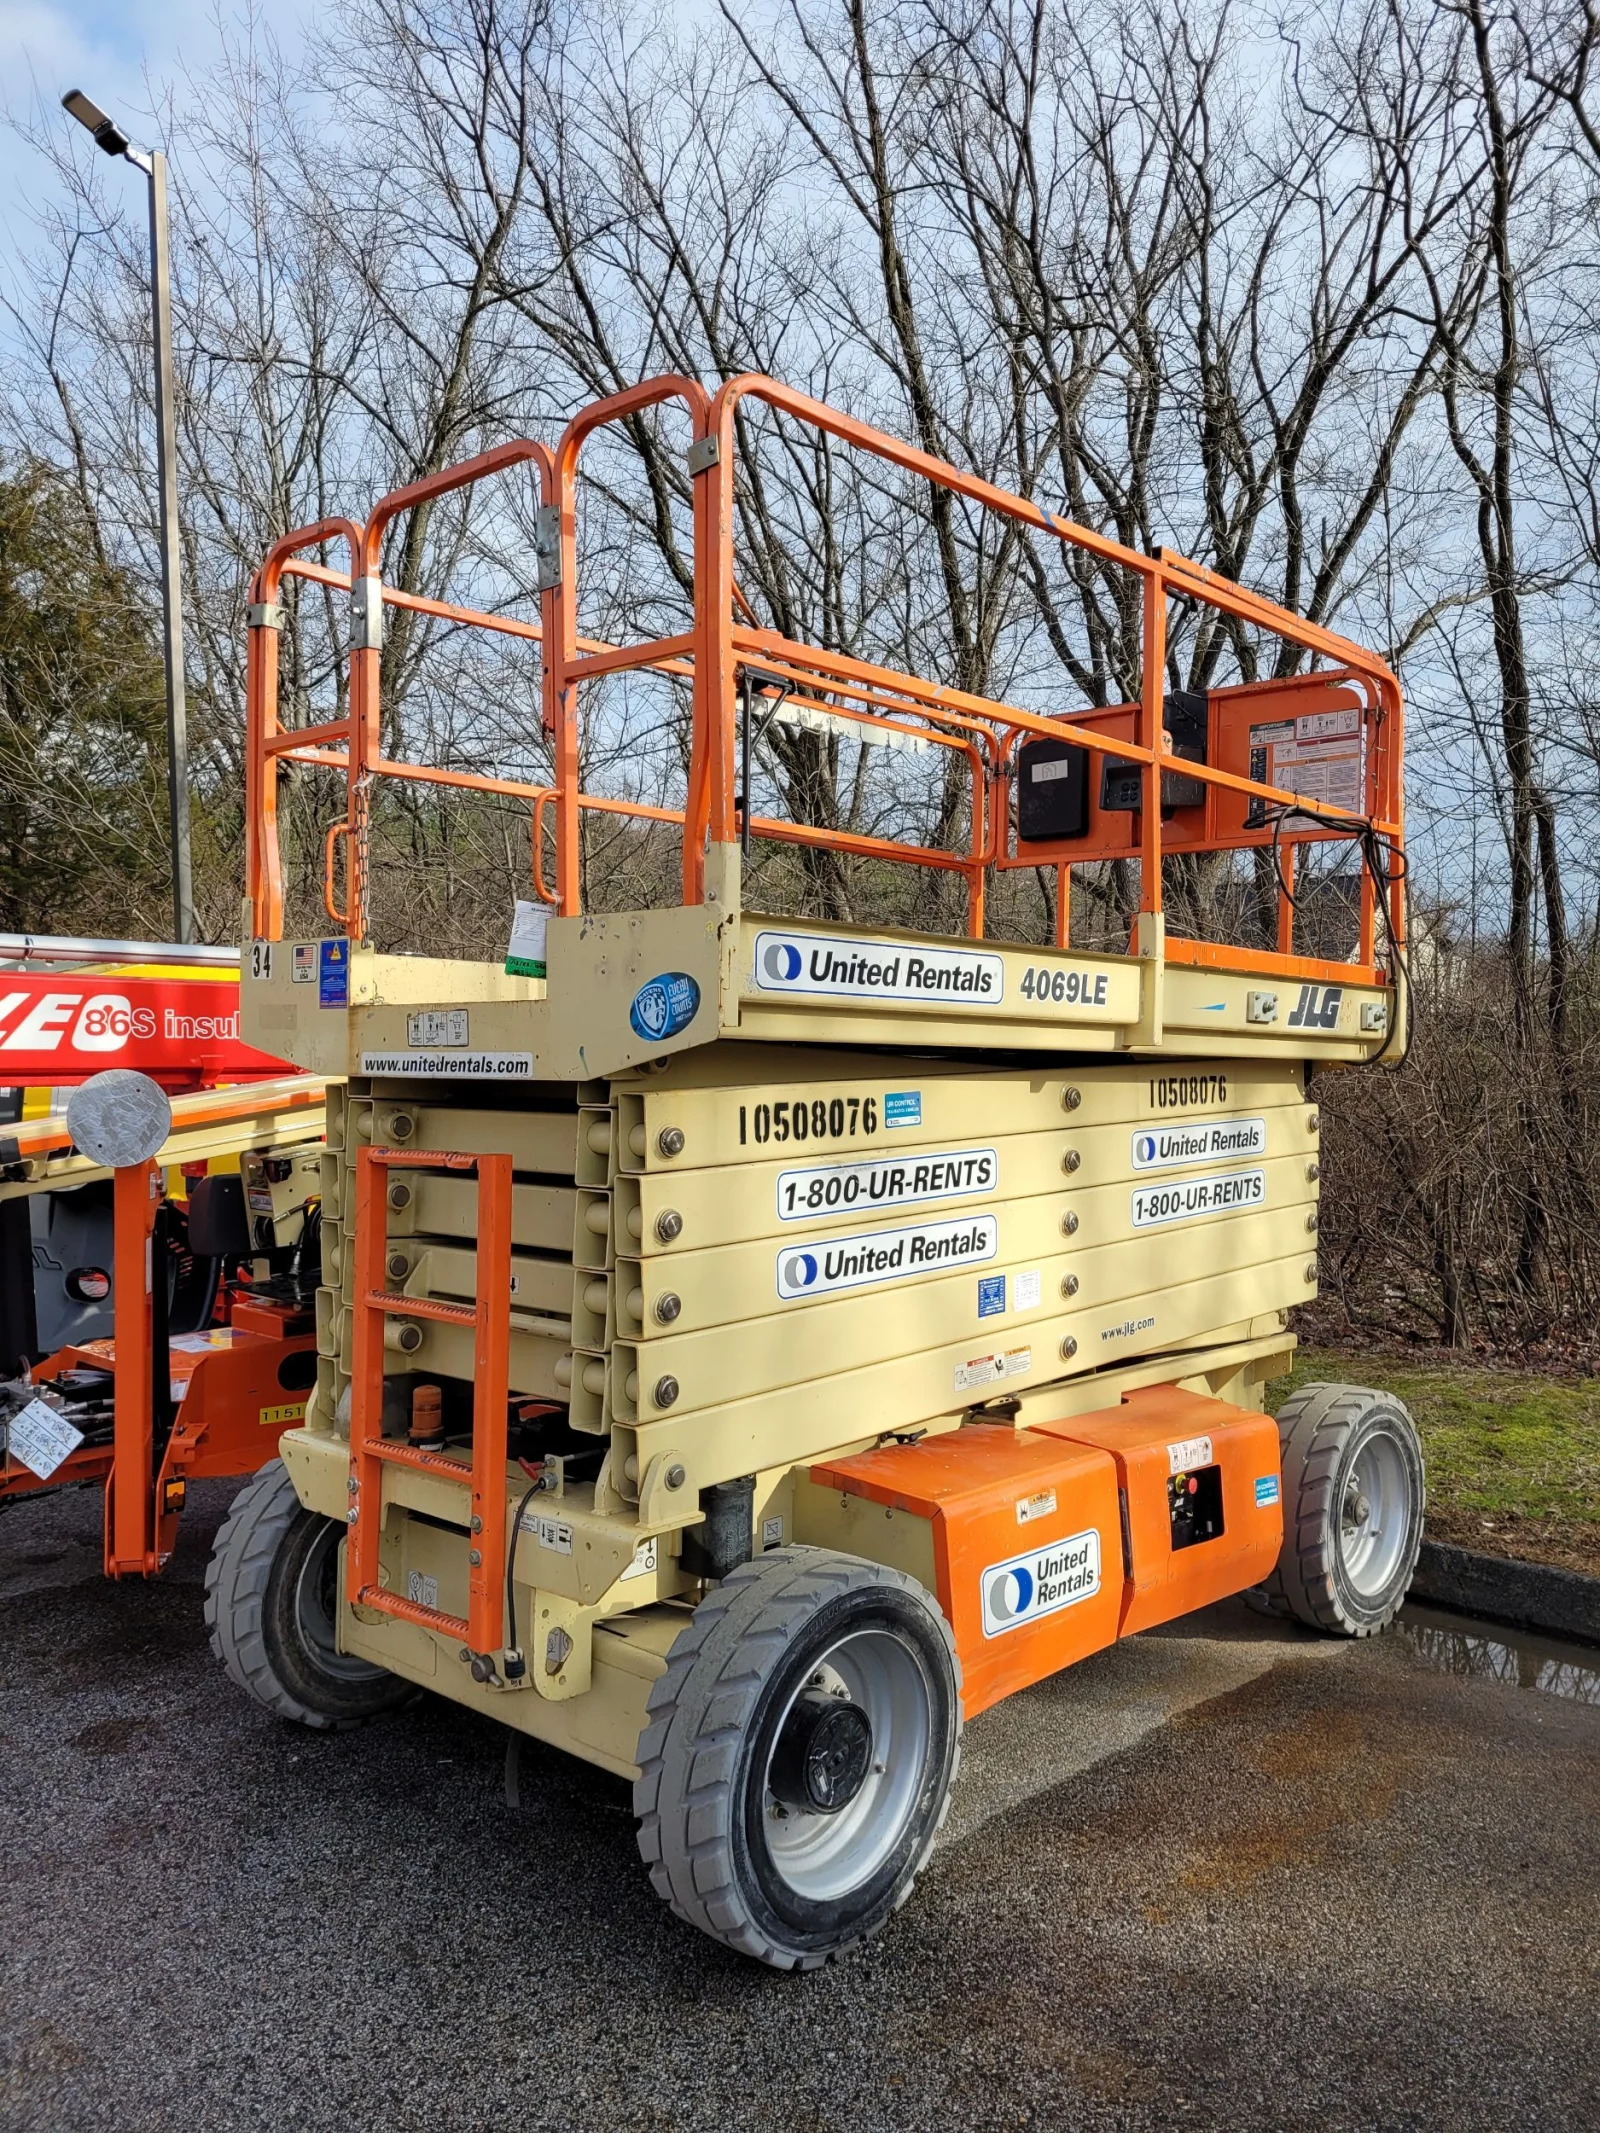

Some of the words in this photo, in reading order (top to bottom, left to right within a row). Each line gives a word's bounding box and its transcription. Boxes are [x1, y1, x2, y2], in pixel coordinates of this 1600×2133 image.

[253, 945, 271, 978] 34
[809, 949, 900, 988] United
[906, 958, 993, 993] Rentals
[1020, 967, 1109, 1005] 4069LE
[1287, 985, 1343, 1029] JLG
[364, 1055, 529, 1074] www.unitedrentals.com
[1150, 1075, 1227, 1108] 10508076
[739, 1097, 877, 1145] 10508076
[1159, 1131, 1207, 1159] United
[1210, 1127, 1260, 1151] Rentals
[785, 1158, 992, 1212] 1-800-UR-RENTS
[1136, 1176, 1262, 1220] 1-800-UR-RENTS
[824, 1240, 904, 1280] United
[909, 1226, 988, 1263] Rentals
[1101, 1316, 1155, 1341] www.jlg.com
[1037, 1543, 1089, 1581] United
[1037, 1567, 1094, 1606] Rentals
